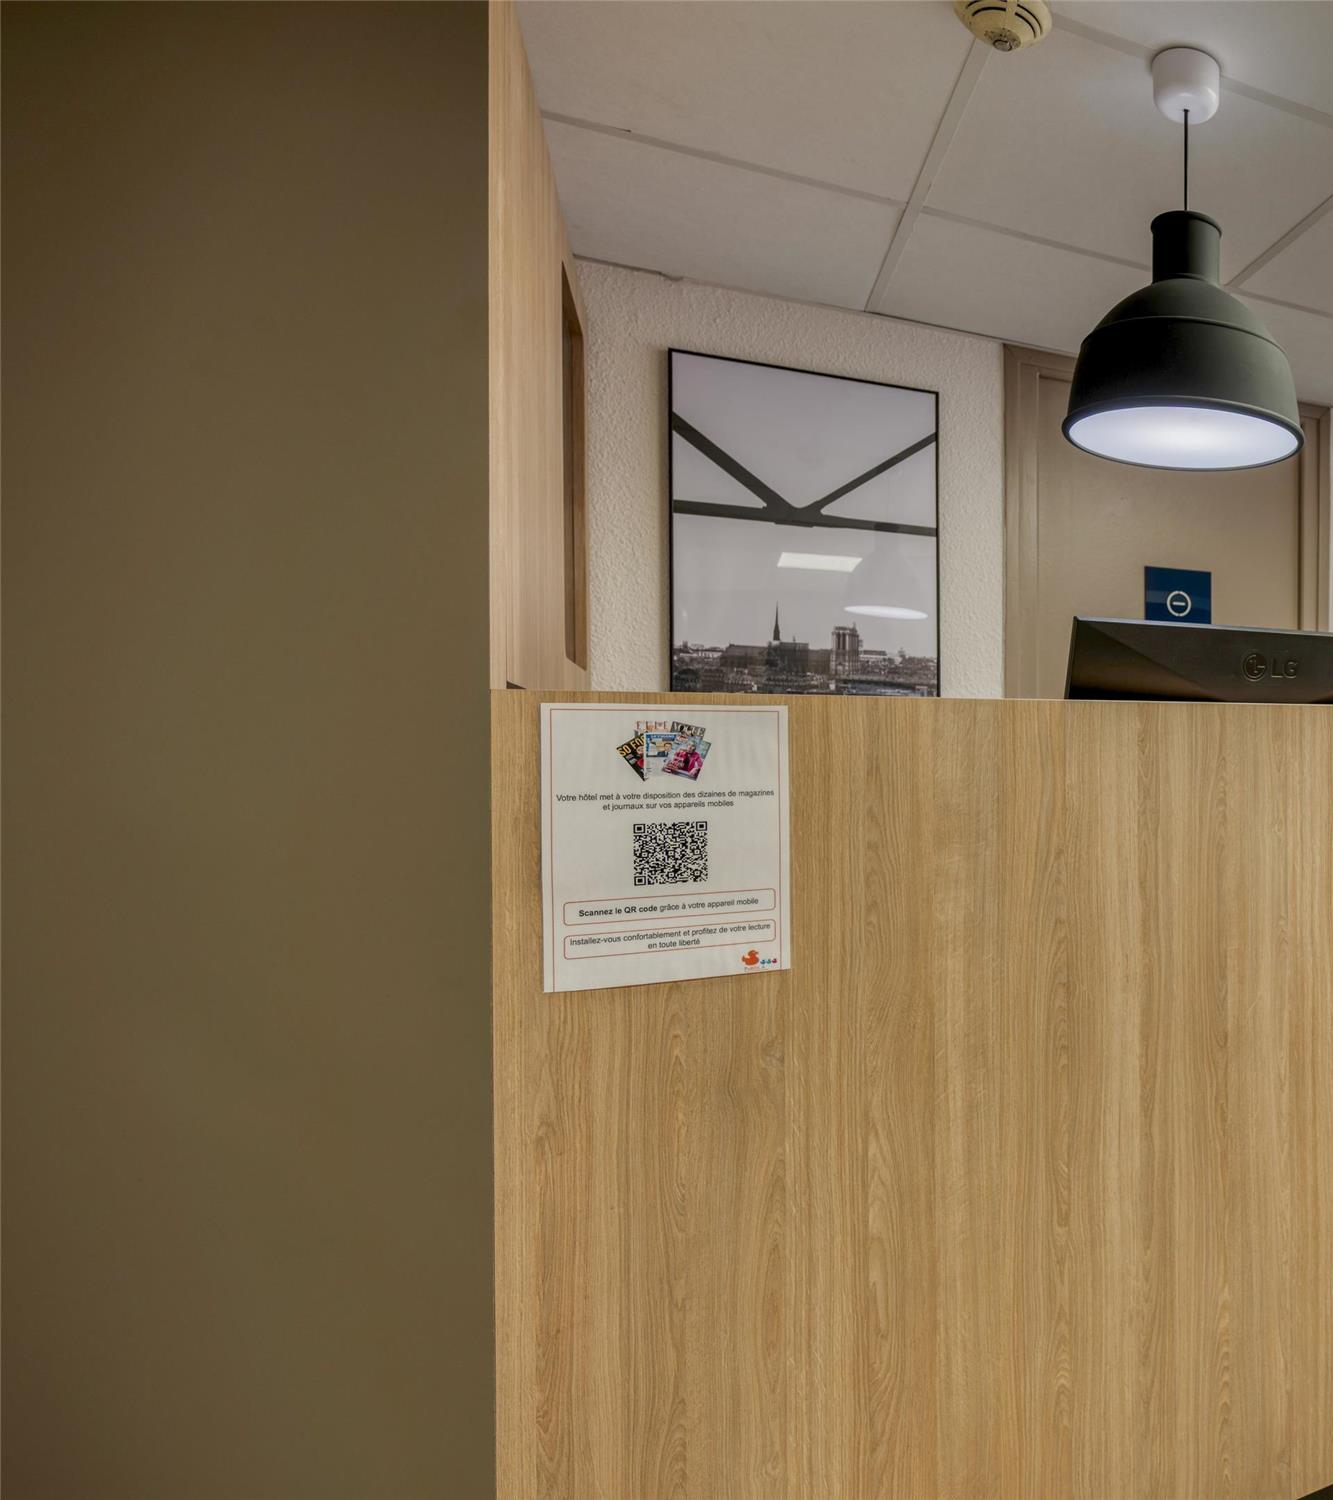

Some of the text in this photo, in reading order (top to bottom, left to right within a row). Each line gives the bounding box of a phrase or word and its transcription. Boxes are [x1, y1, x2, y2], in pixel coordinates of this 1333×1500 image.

[1270, 656, 1298, 679] LG
[616, 744, 632, 756] SO
[556, 794, 576, 802] Votre
[578, 793, 597, 801] hôtel
[643, 792, 680, 801] disposition
[697, 790, 726, 798] dizaines
[738, 789, 774, 798] magazines
[611, 803, 644, 811] journaux
[674, 800, 706, 809] appareils
[578, 909, 613, 917] Scannez
[624, 906, 637, 914] QR
[659, 904, 680, 912] grâce
[707, 899, 735, 909] appareil
[569, 936, 621, 946] Installez-vous
[623, 930, 681, 941] confortablement
[692, 927, 717, 937] profitez
[730, 924, 746, 932] votre
[659, 940, 677, 948] toute
[679, 938, 701, 946] liberté
